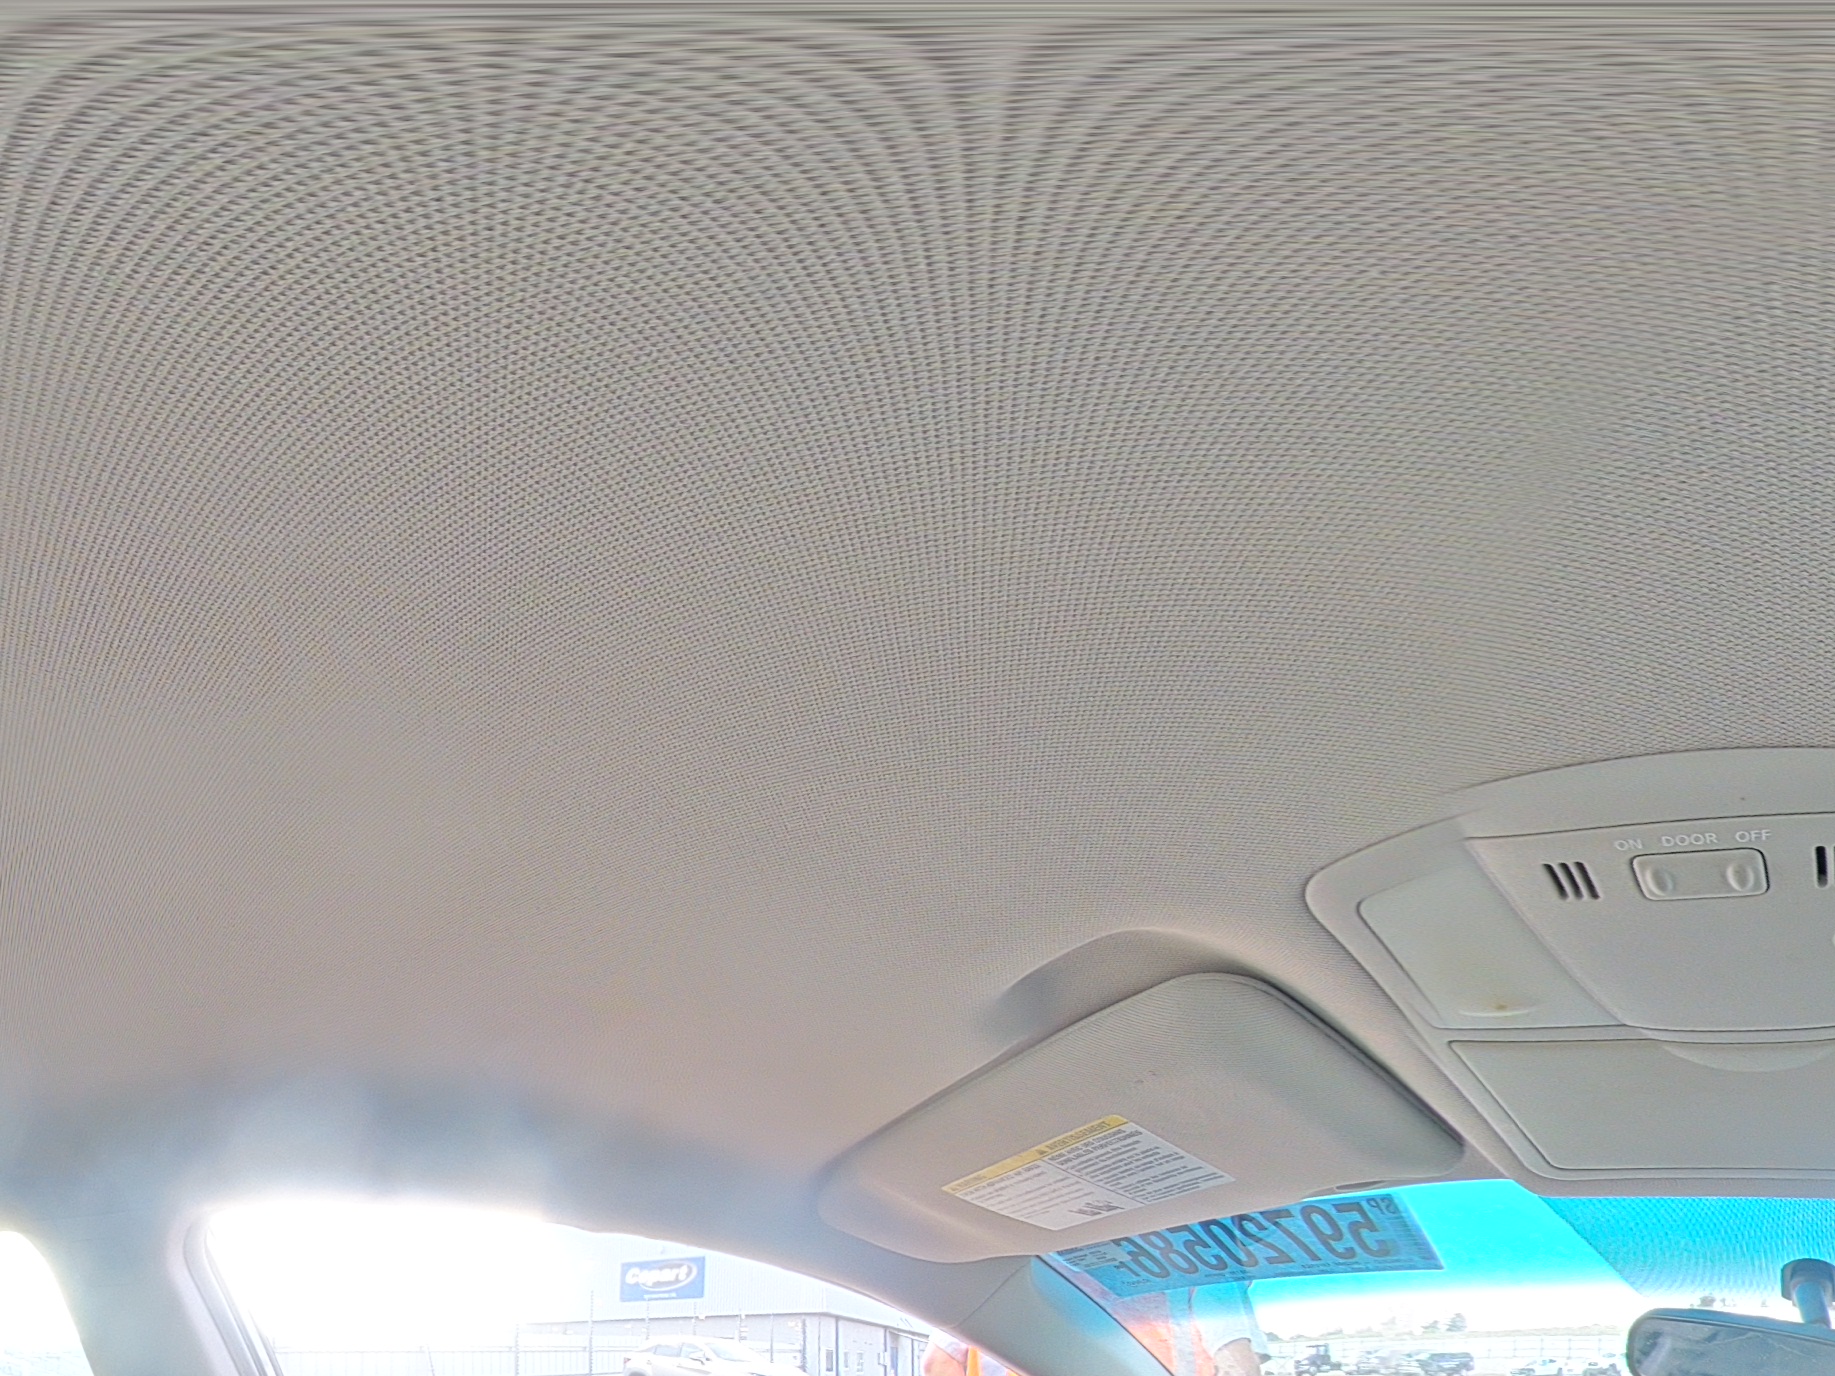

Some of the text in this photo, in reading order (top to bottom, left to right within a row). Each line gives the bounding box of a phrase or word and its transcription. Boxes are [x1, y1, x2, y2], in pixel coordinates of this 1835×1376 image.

[1614, 830, 1772, 851] ON DOOR OFF
[625, 1264, 688, 1286] Copart
